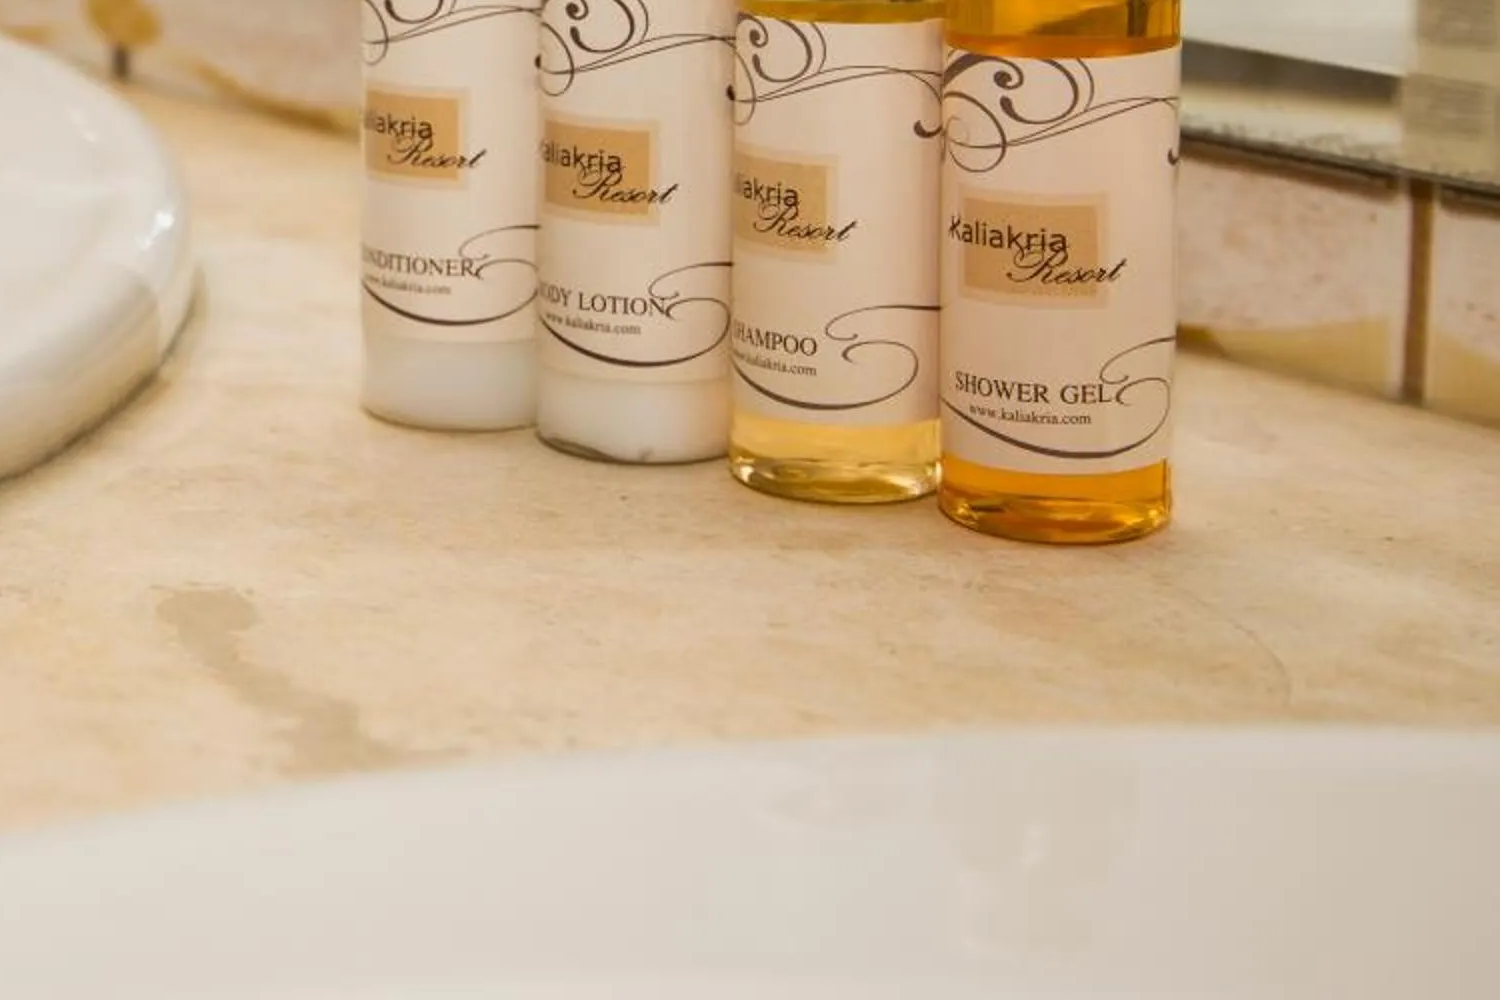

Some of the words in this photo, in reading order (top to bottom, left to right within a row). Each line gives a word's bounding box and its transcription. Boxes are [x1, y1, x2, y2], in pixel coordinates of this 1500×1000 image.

[571, 168, 679, 204] Resort
[752, 201, 858, 241] Resort
[1005, 249, 1128, 286] Resort
[578, 291, 667, 317] LOTION
[954, 370, 1050, 404] SHOWER
[1059, 382, 1113, 405] GEL
[968, 403, 1092, 426] www.kaliakria.com
